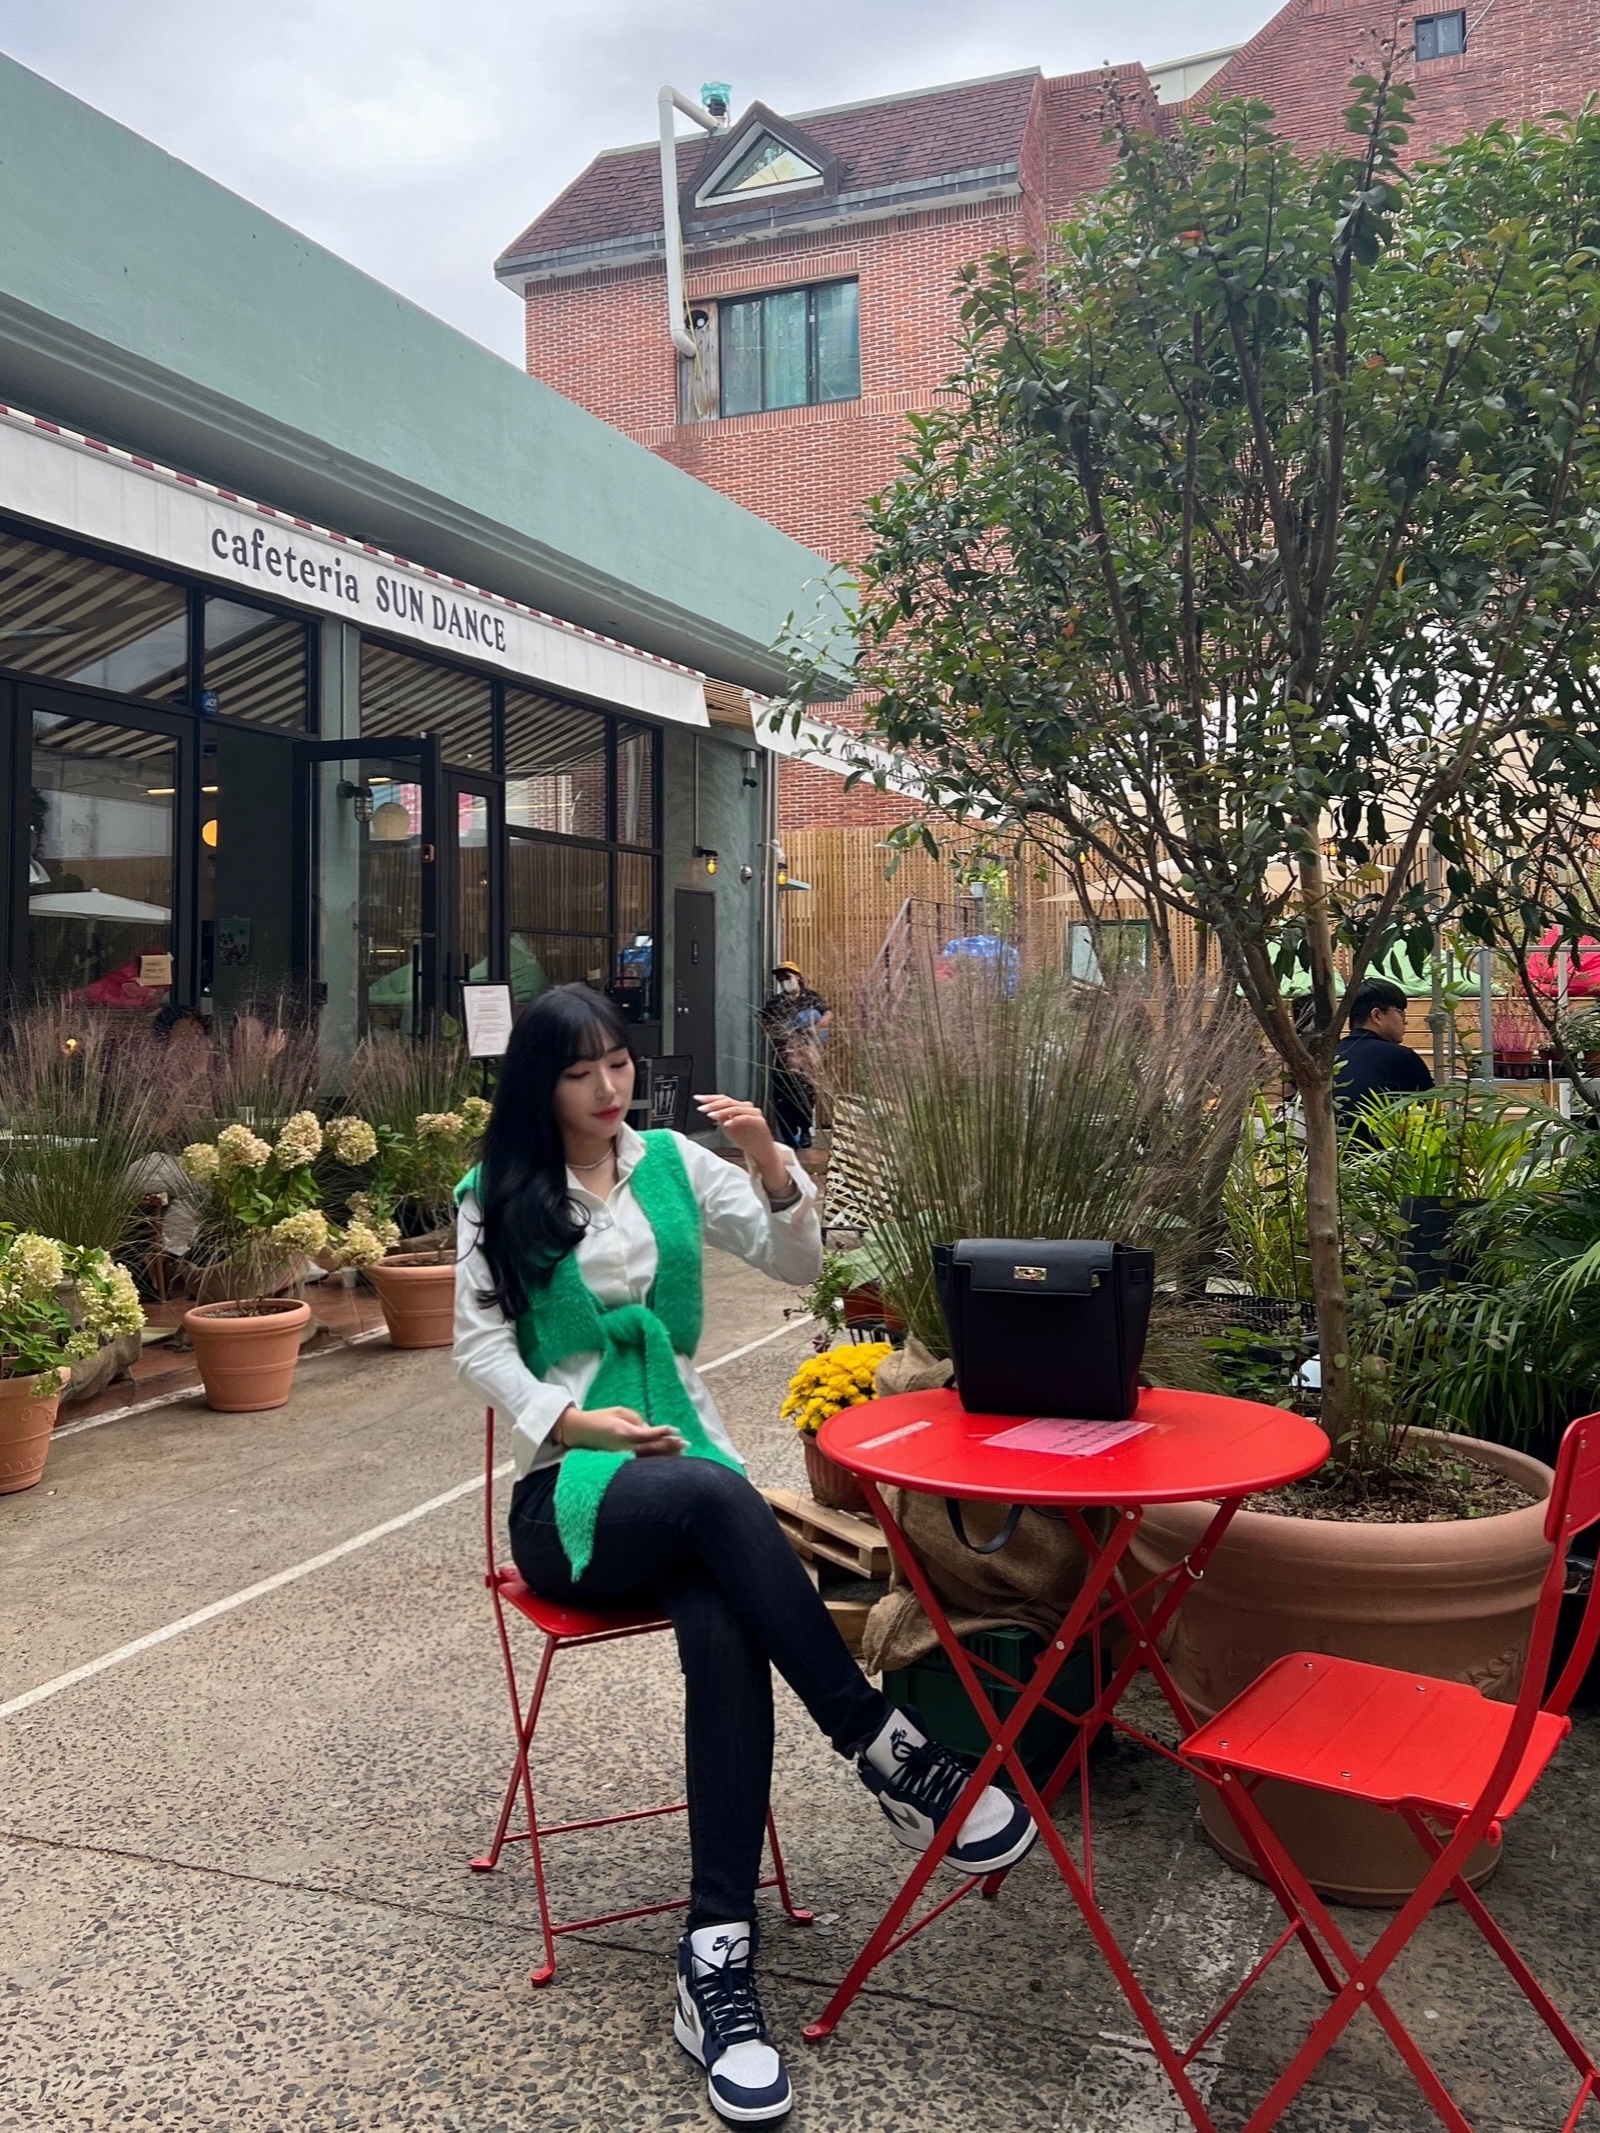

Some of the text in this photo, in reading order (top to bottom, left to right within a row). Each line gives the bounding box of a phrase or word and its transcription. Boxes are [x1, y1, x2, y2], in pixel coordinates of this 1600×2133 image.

[211, 528, 507, 653] cafeteria SUN DANCE
